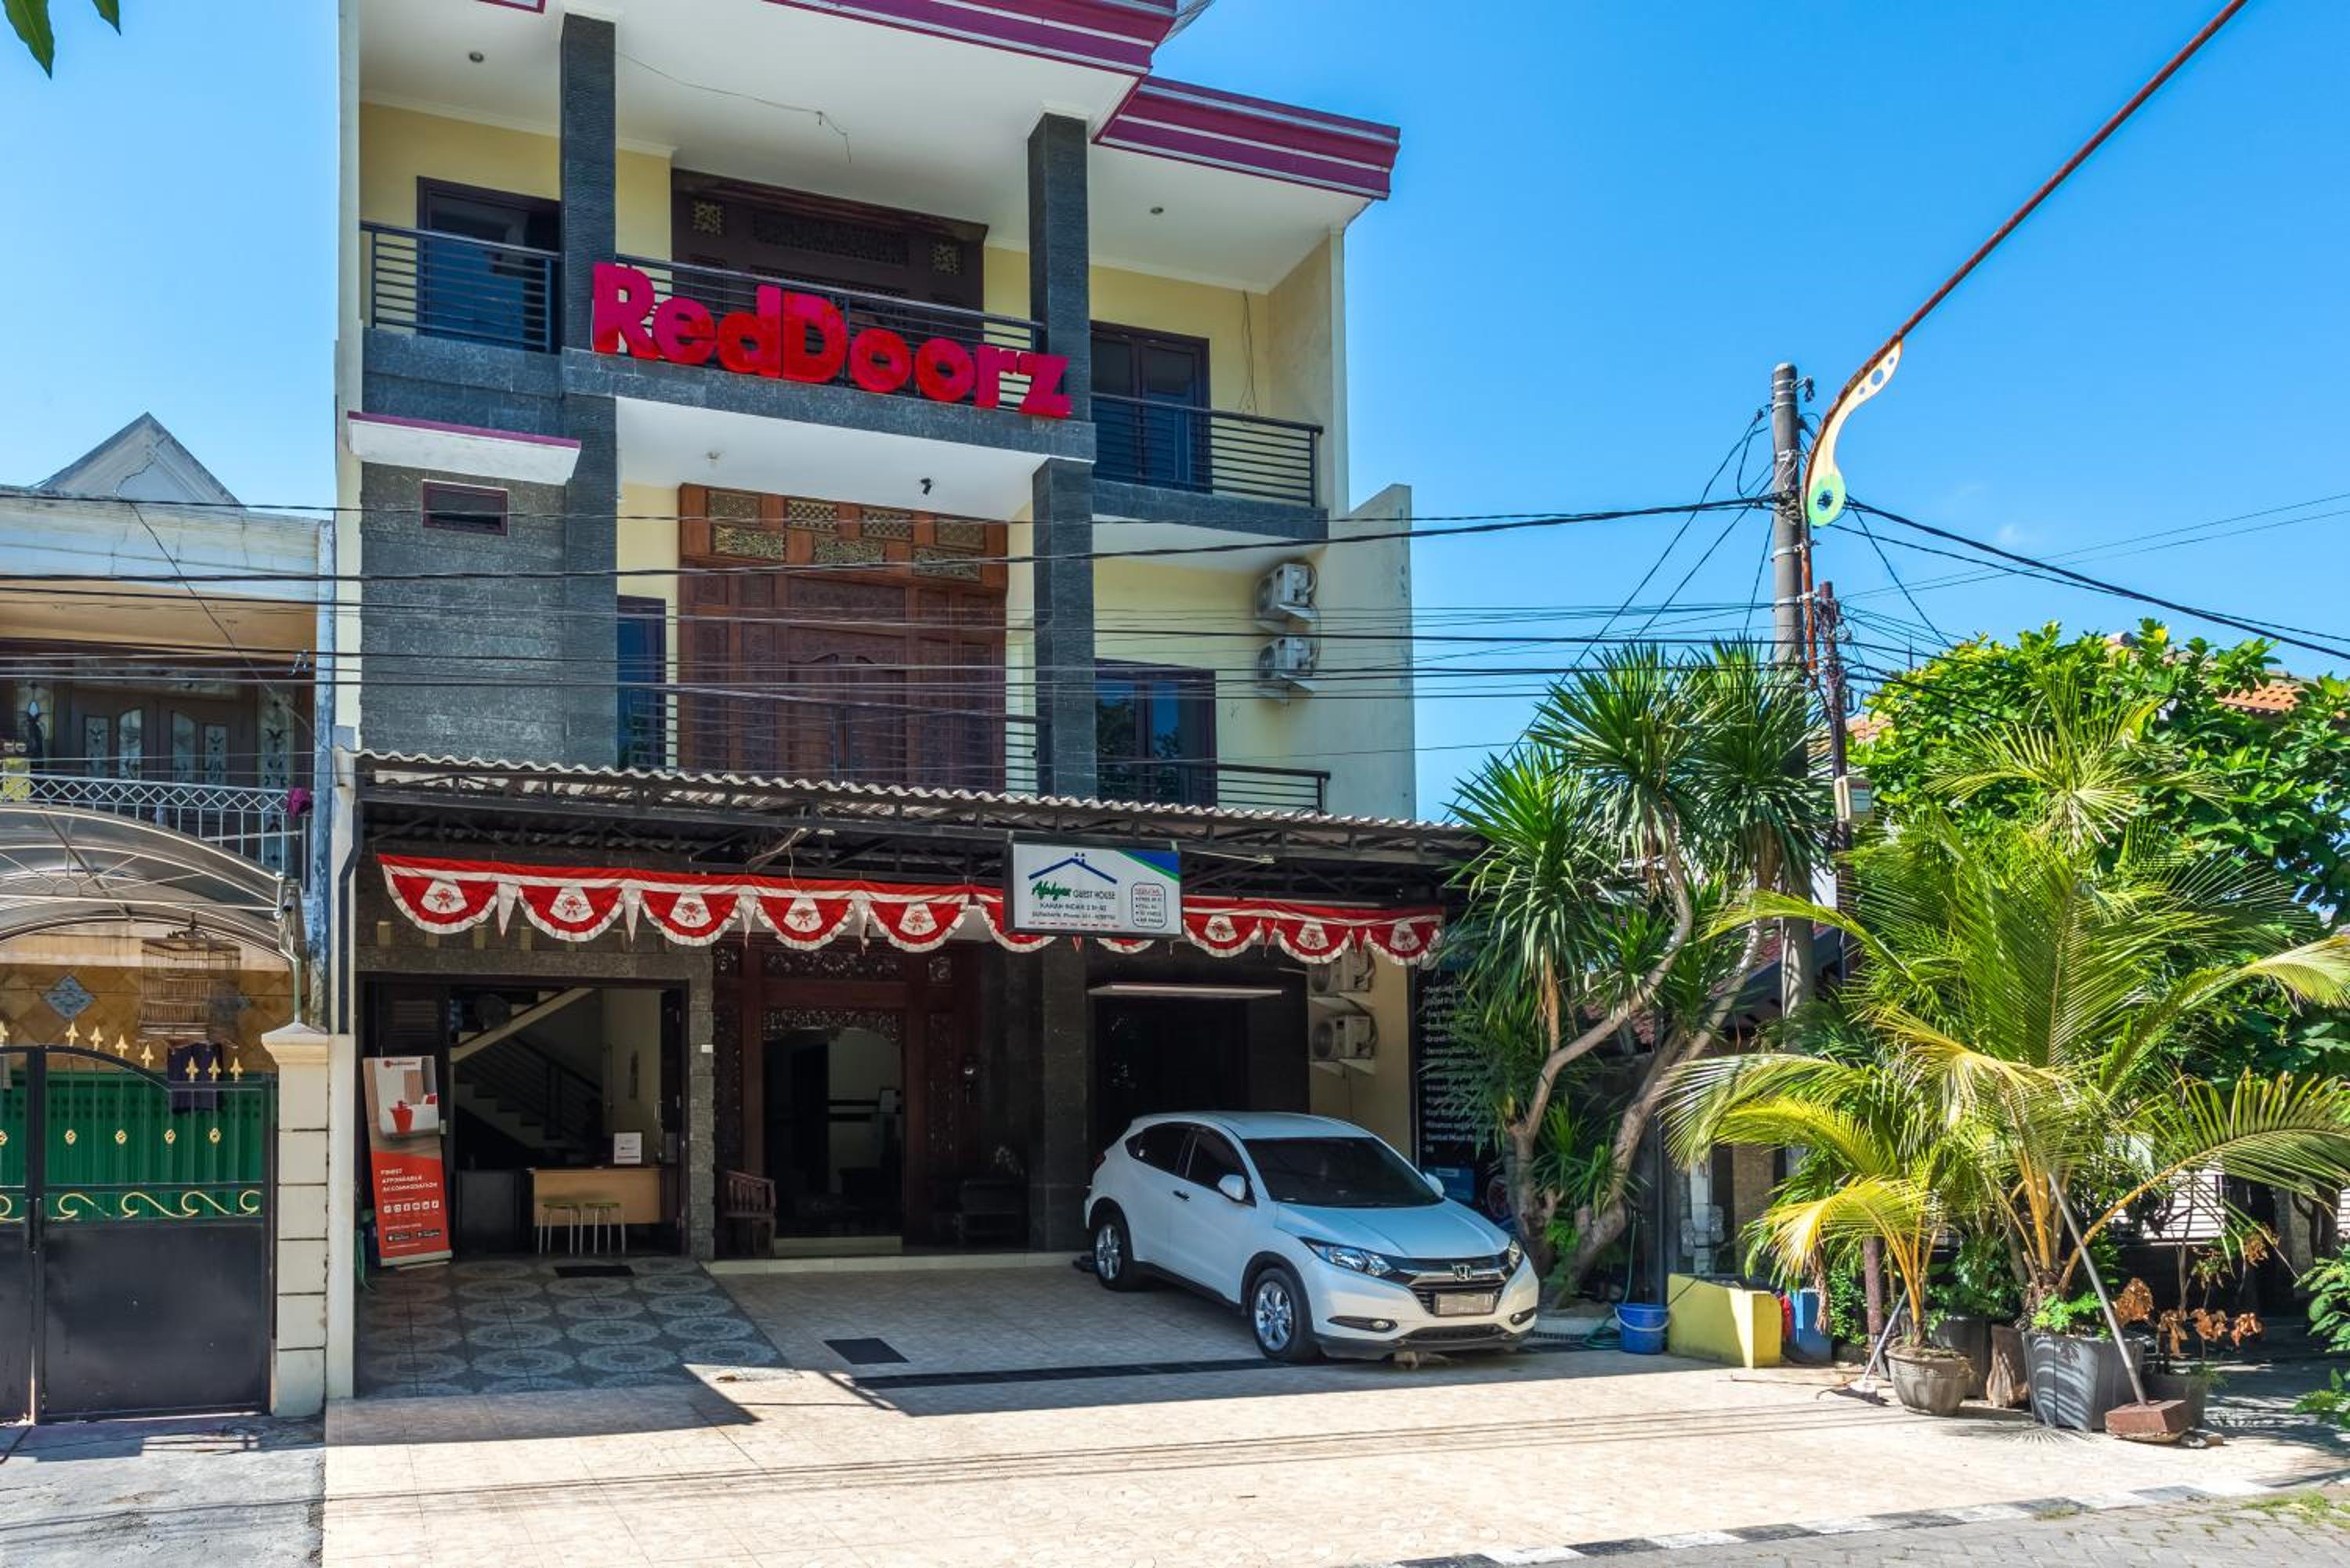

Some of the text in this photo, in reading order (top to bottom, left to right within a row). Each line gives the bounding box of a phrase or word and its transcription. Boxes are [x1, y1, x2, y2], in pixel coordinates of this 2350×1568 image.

[592, 262, 1072, 419] RedDoorz
[1072, 890, 1093, 898] GUEST
[1095, 891, 1115, 900] HOUSE
